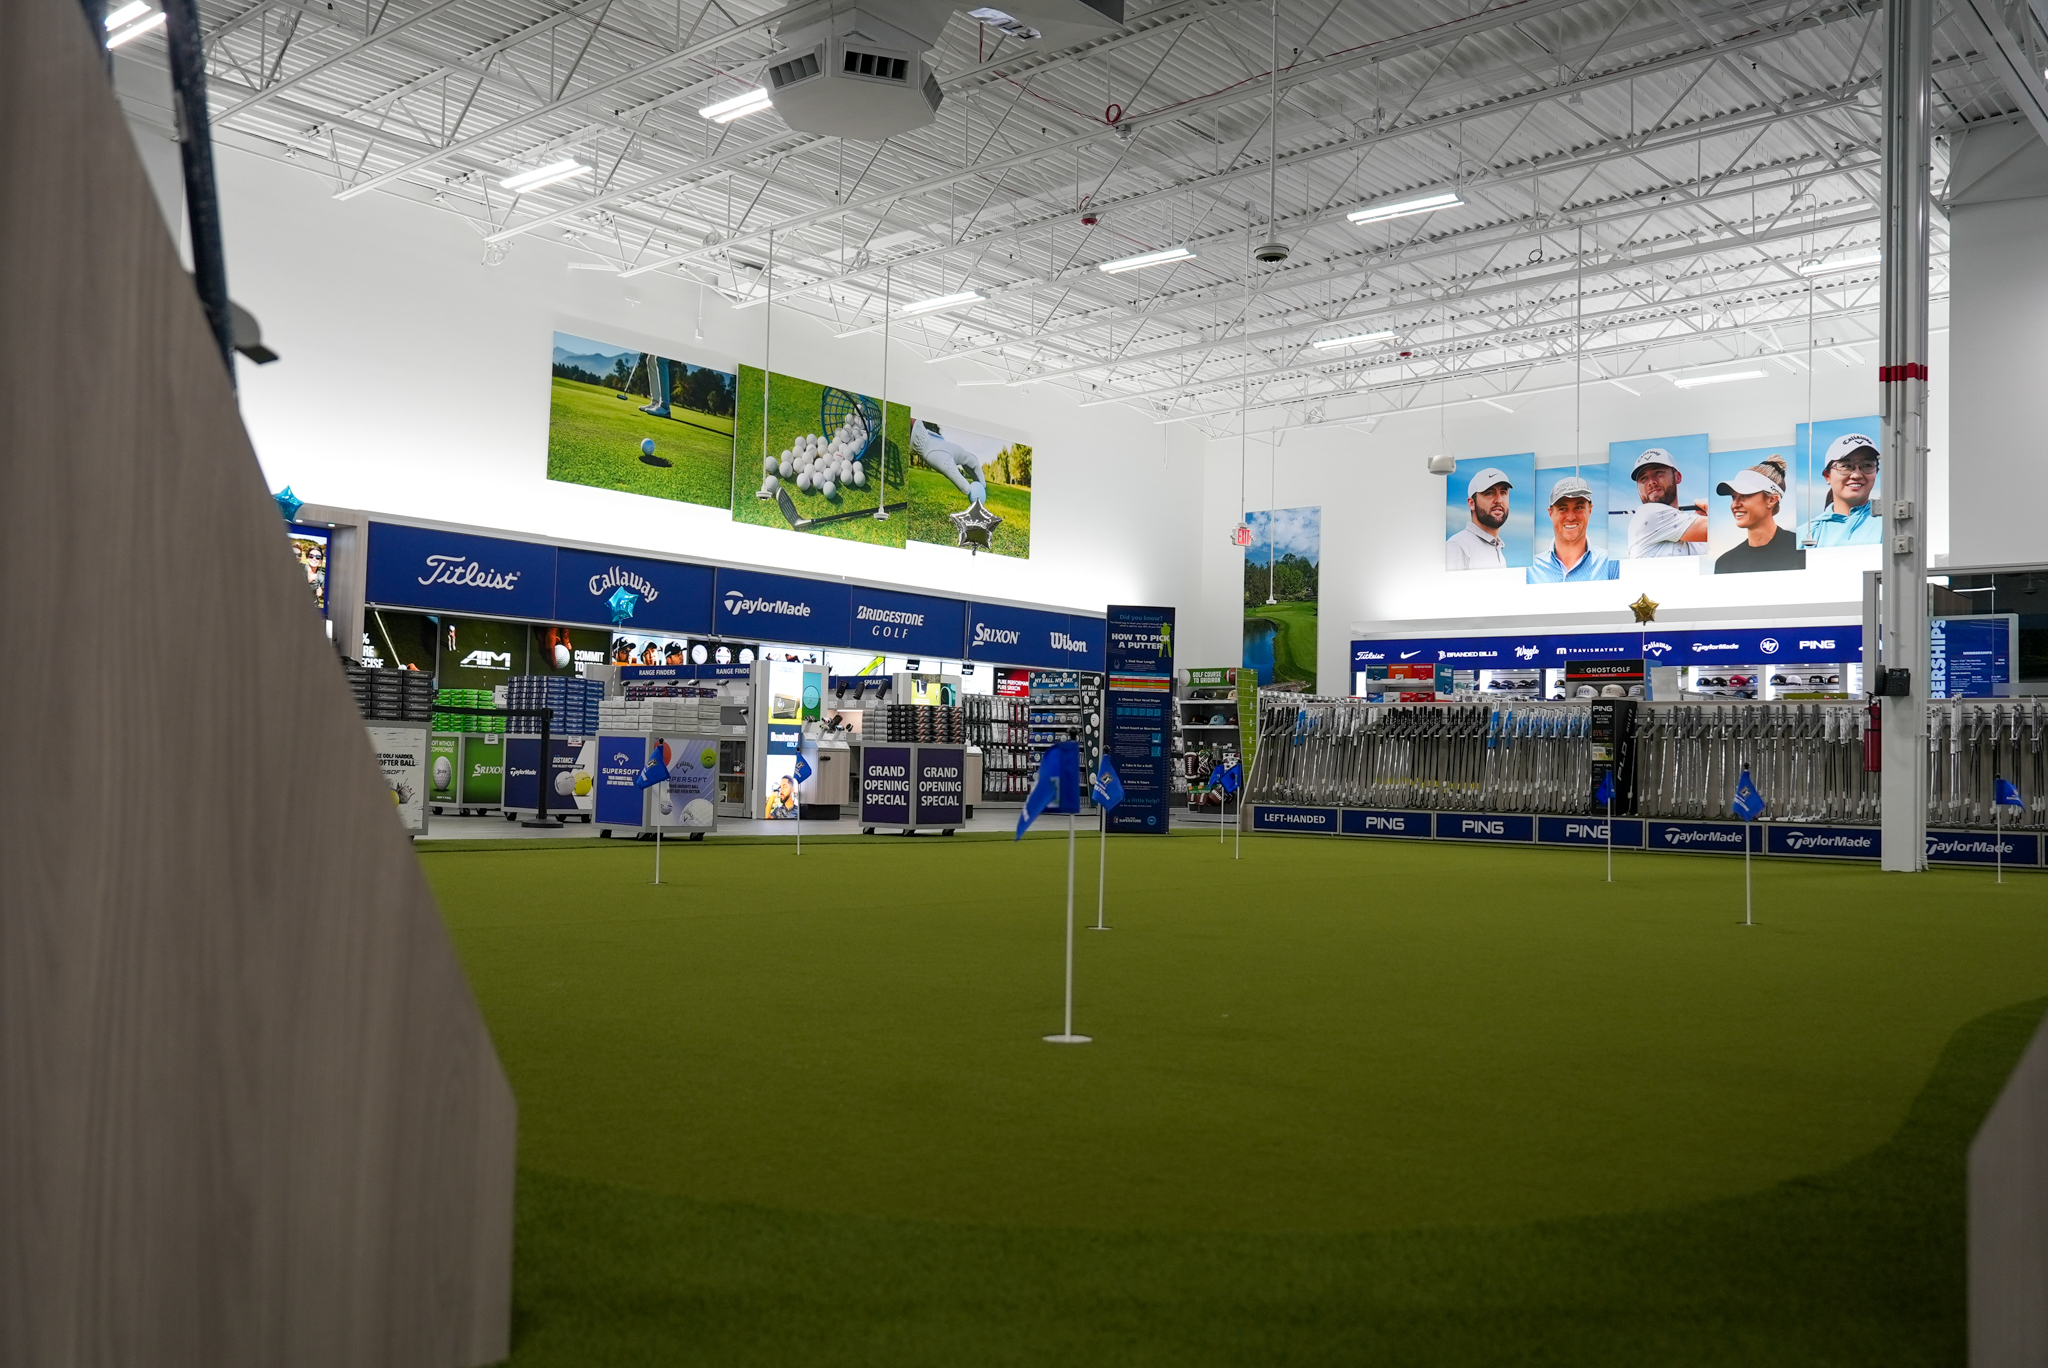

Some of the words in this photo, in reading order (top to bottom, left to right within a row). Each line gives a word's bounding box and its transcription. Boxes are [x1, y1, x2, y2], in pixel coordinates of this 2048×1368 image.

[1237, 528, 1250, 545] EXIT
[418, 554, 518, 591] Titleist
[588, 565, 660, 604] Callaway
[724, 590, 811, 617] TaylorMade
[856, 605, 925, 626] BRIDGESTONE
[872, 624, 909, 639] GOLF
[971, 622, 1020, 647] SRIXON
[1111, 633, 1133, 641] HOW
[1150, 634, 1170, 642] PICK
[1050, 631, 1088, 653] Wilson
[1118, 641, 1126, 649] A
[1127, 642, 1164, 650] PUTTER
[1642, 640, 1673, 652] Callaway
[1692, 643, 1739, 652] TaylorMade
[1799, 640, 1836, 650] PING
[574, 649, 605, 662] COMMIT
[1355, 650, 1386, 661] Titleist
[1478, 650, 1498, 658] BILLS
[510, 767, 537, 777] TaylorMade
[602, 767, 640, 775] SUPERSOFT
[868, 765, 906, 777] GRAND
[923, 766, 958, 778] GRAND
[864, 779, 910, 792] OPENING
[919, 781, 962, 792] OPENING
[866, 794, 907, 806] SPECIAL
[921, 795, 960, 806] SPECIAL
[1264, 813, 1326, 824] LEFT-HANDED
[1365, 816, 1405, 831] PING
[1462, 820, 1504, 835] PING
[1565, 823, 1611, 839] PING
[1664, 827, 1742, 845] TaylorMade
[1786, 831, 1871, 850] TaylorMade
